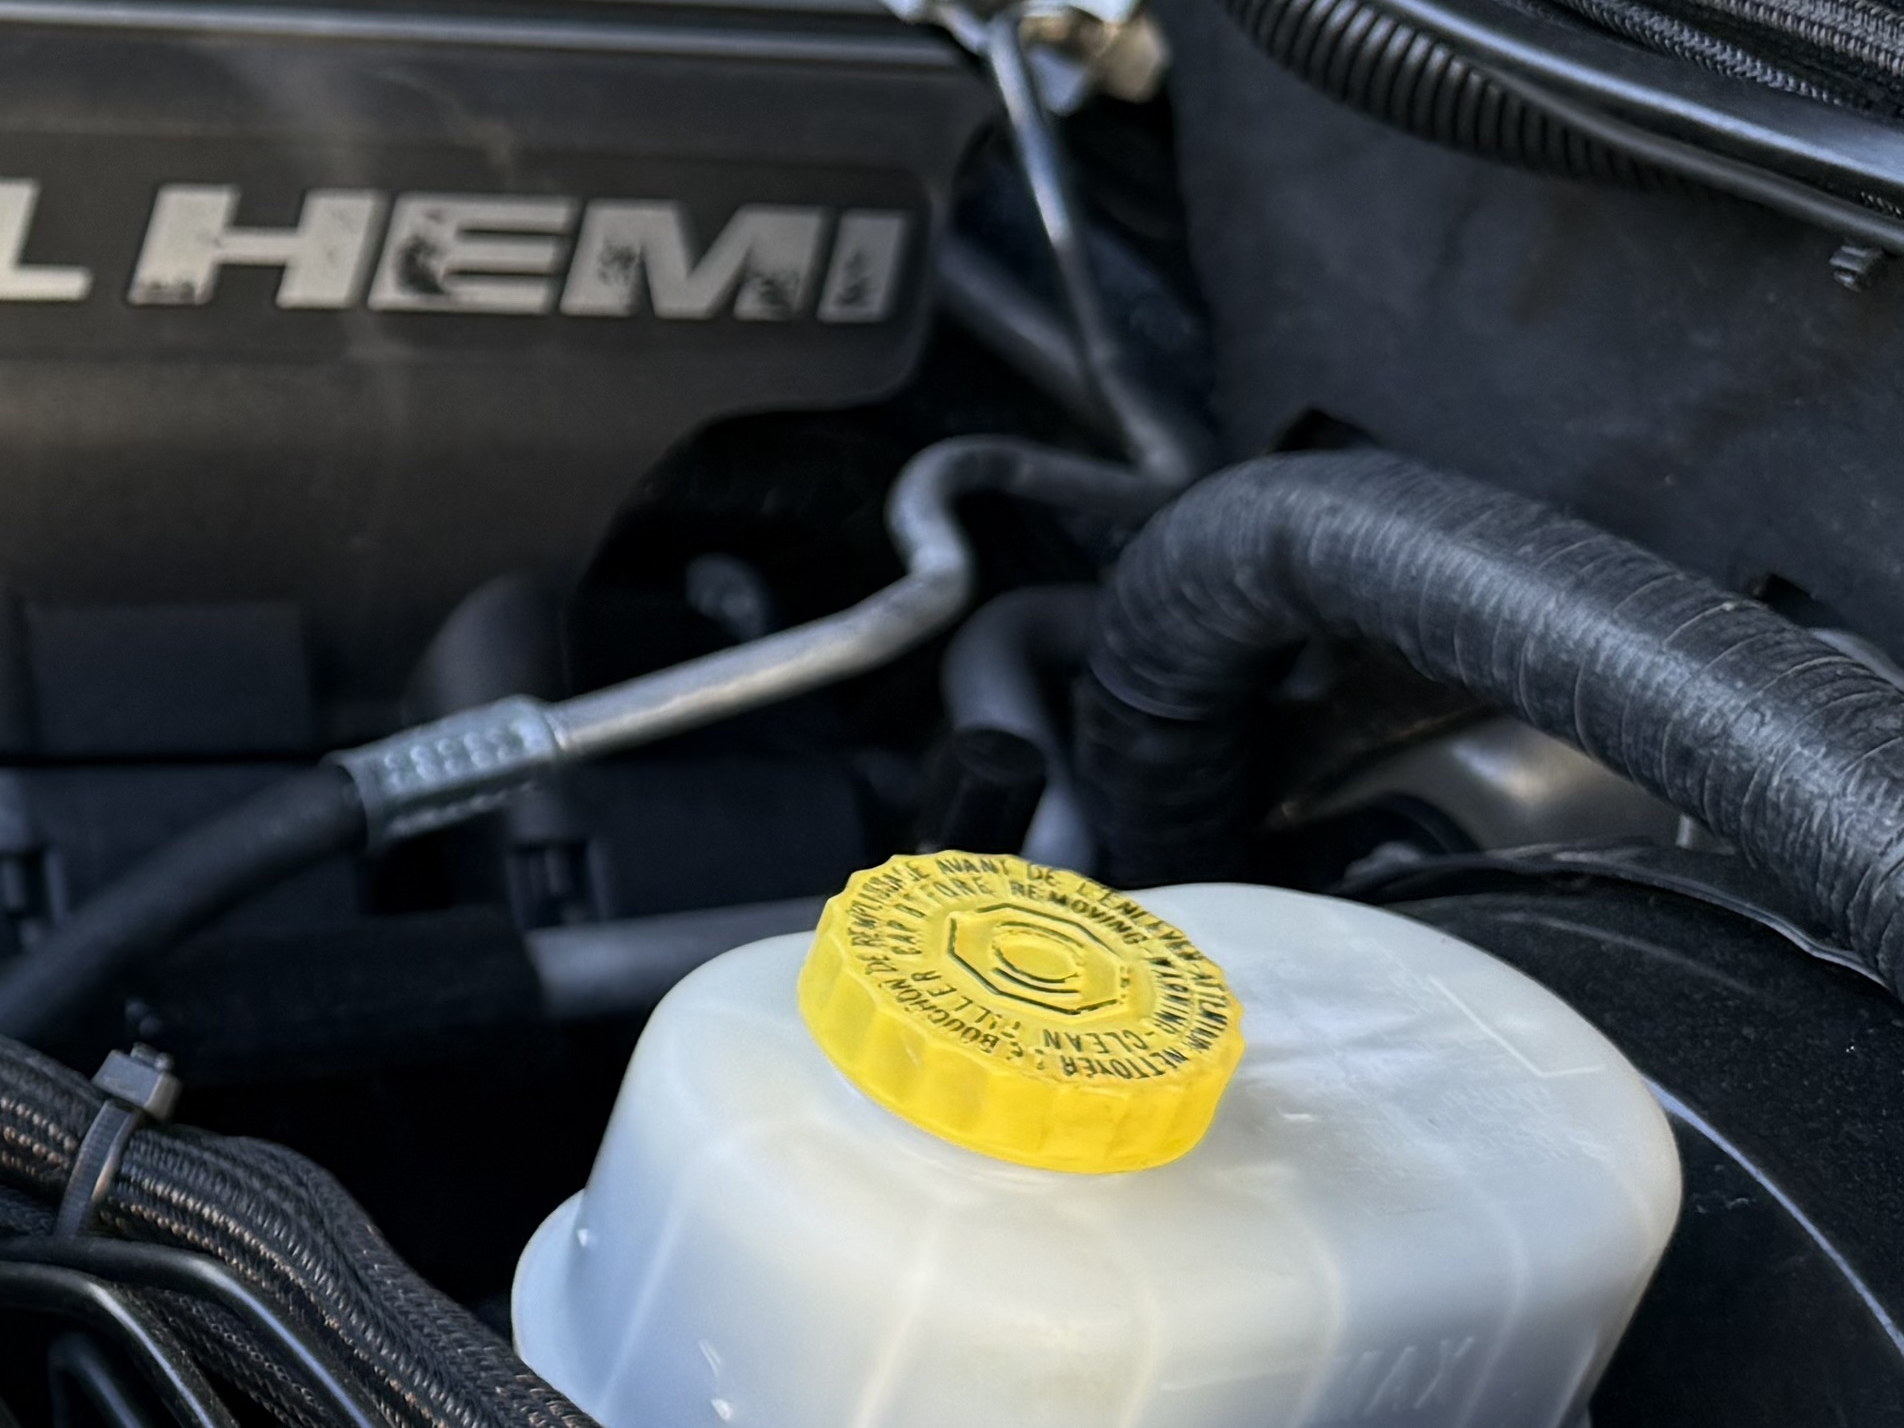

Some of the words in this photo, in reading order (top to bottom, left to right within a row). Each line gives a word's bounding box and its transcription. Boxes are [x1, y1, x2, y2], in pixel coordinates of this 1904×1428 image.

[128, 186, 914, 323] HEMI
[1009, 879, 1144, 945] REMOVING
[879, 978, 1001, 1054] BOUCHON
